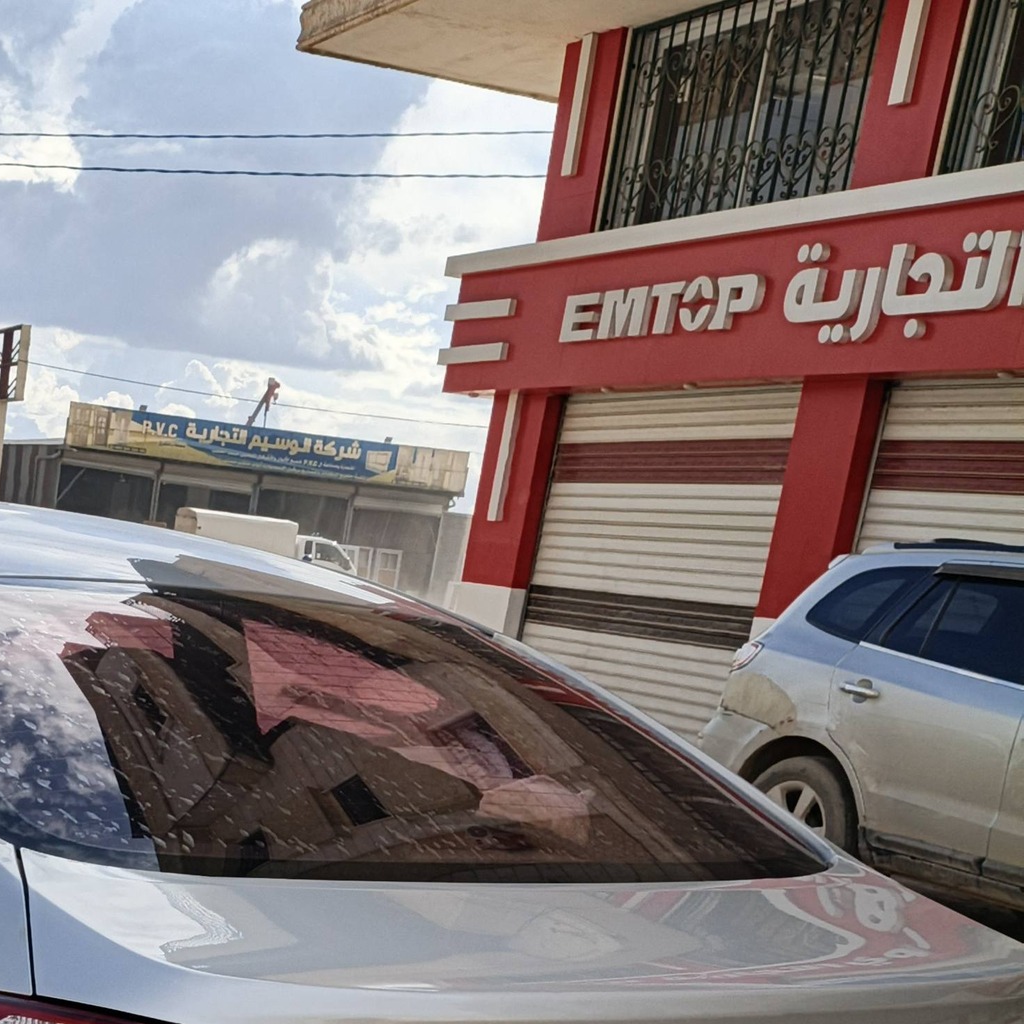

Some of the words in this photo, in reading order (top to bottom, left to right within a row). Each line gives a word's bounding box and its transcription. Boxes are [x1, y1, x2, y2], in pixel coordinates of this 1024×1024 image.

[559, 274, 766, 343] EMTOP
[186, 422, 248, 446] التجارية
[248, 434, 312, 455] الوسيم
[313, 440, 362, 461] شركة
